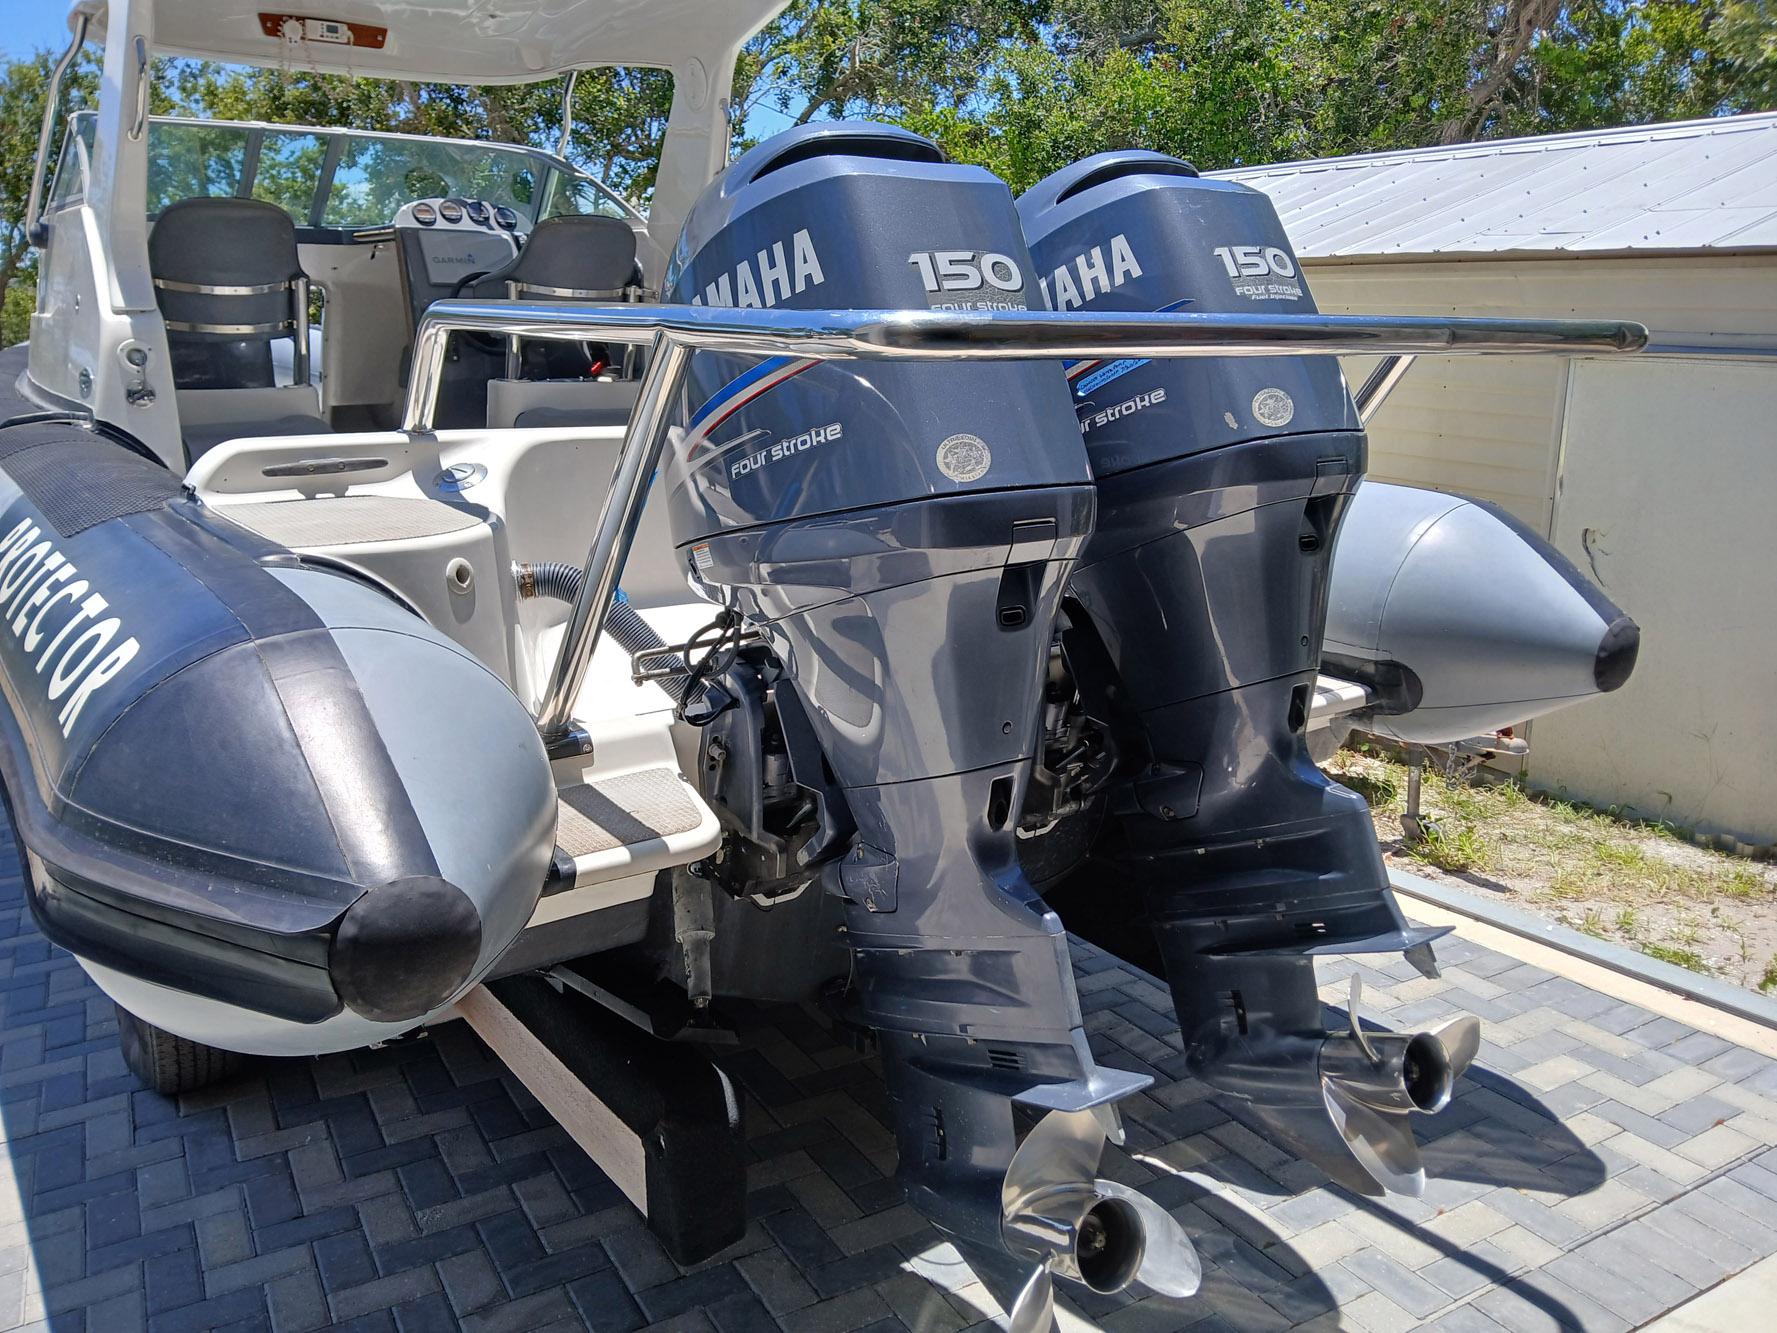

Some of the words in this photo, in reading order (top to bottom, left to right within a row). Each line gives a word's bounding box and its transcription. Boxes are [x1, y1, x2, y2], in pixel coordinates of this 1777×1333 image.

[432, 254, 476, 265] GARMIN
[692, 228, 825, 308] MAHA
[908, 251, 1024, 293] 150
[1039, 233, 1143, 312] AHA
[1214, 246, 1296, 279] 150
[1096, 388, 1167, 428] stroke
[771, 423, 843, 461] stroke
[0, 517, 141, 739] PROTECTOR
